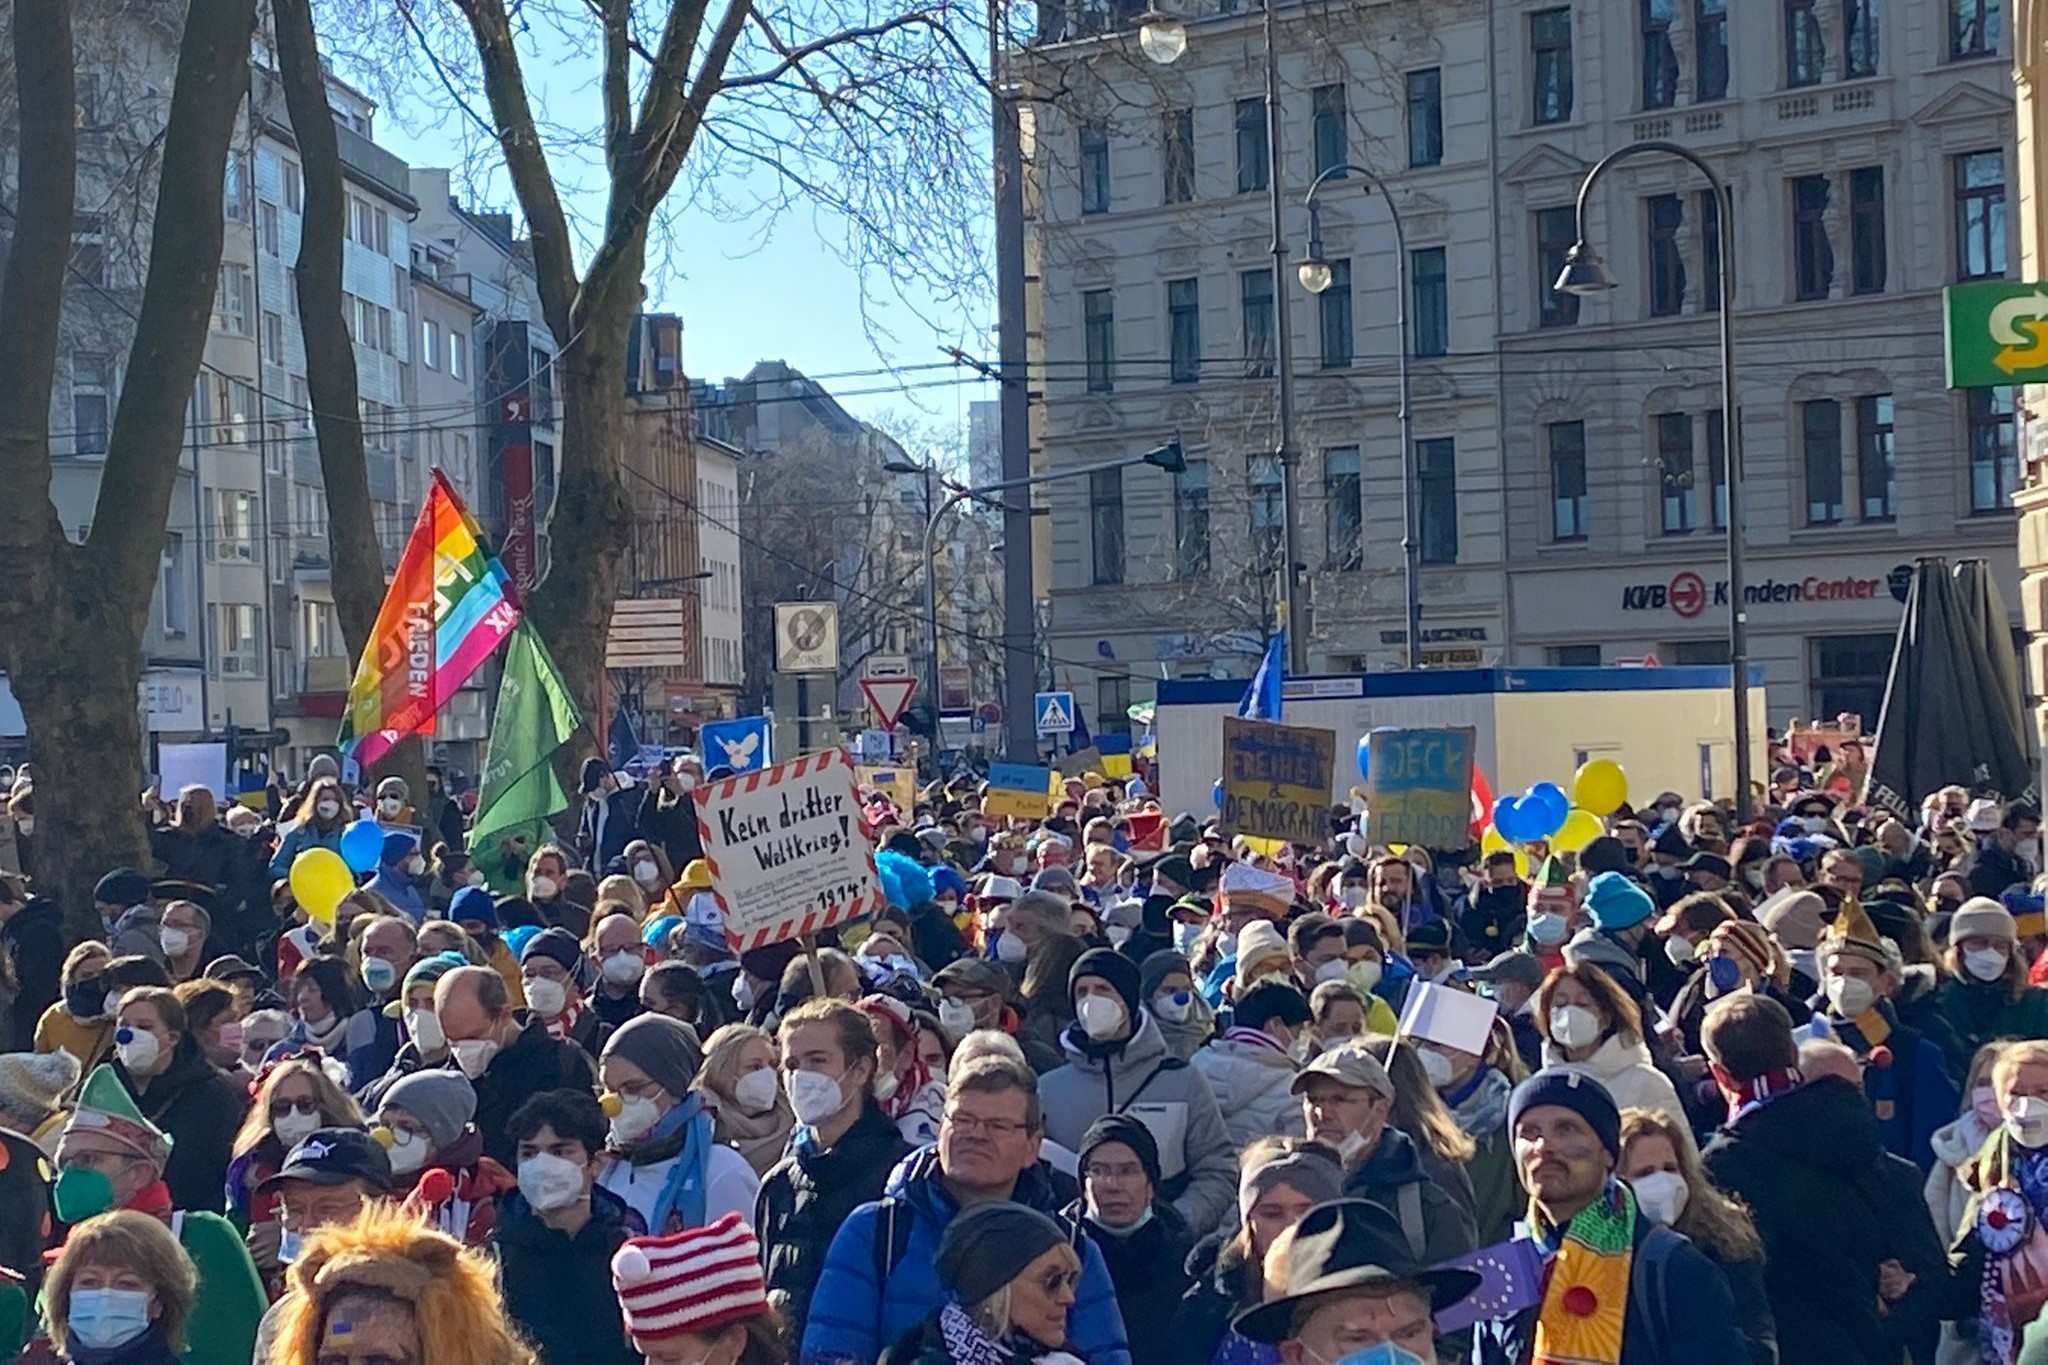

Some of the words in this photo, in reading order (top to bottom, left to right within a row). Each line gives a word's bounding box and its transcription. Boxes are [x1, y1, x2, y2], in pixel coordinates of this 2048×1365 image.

[1622, 584, 1667, 610] KVB
[1713, 576, 1880, 606] KndenCenter
[407, 602, 430, 699] FRIEDEN
[719, 806, 761, 847] Kein
[779, 785, 843, 829] dritter
[754, 815, 850, 870] Weltkrieg!
